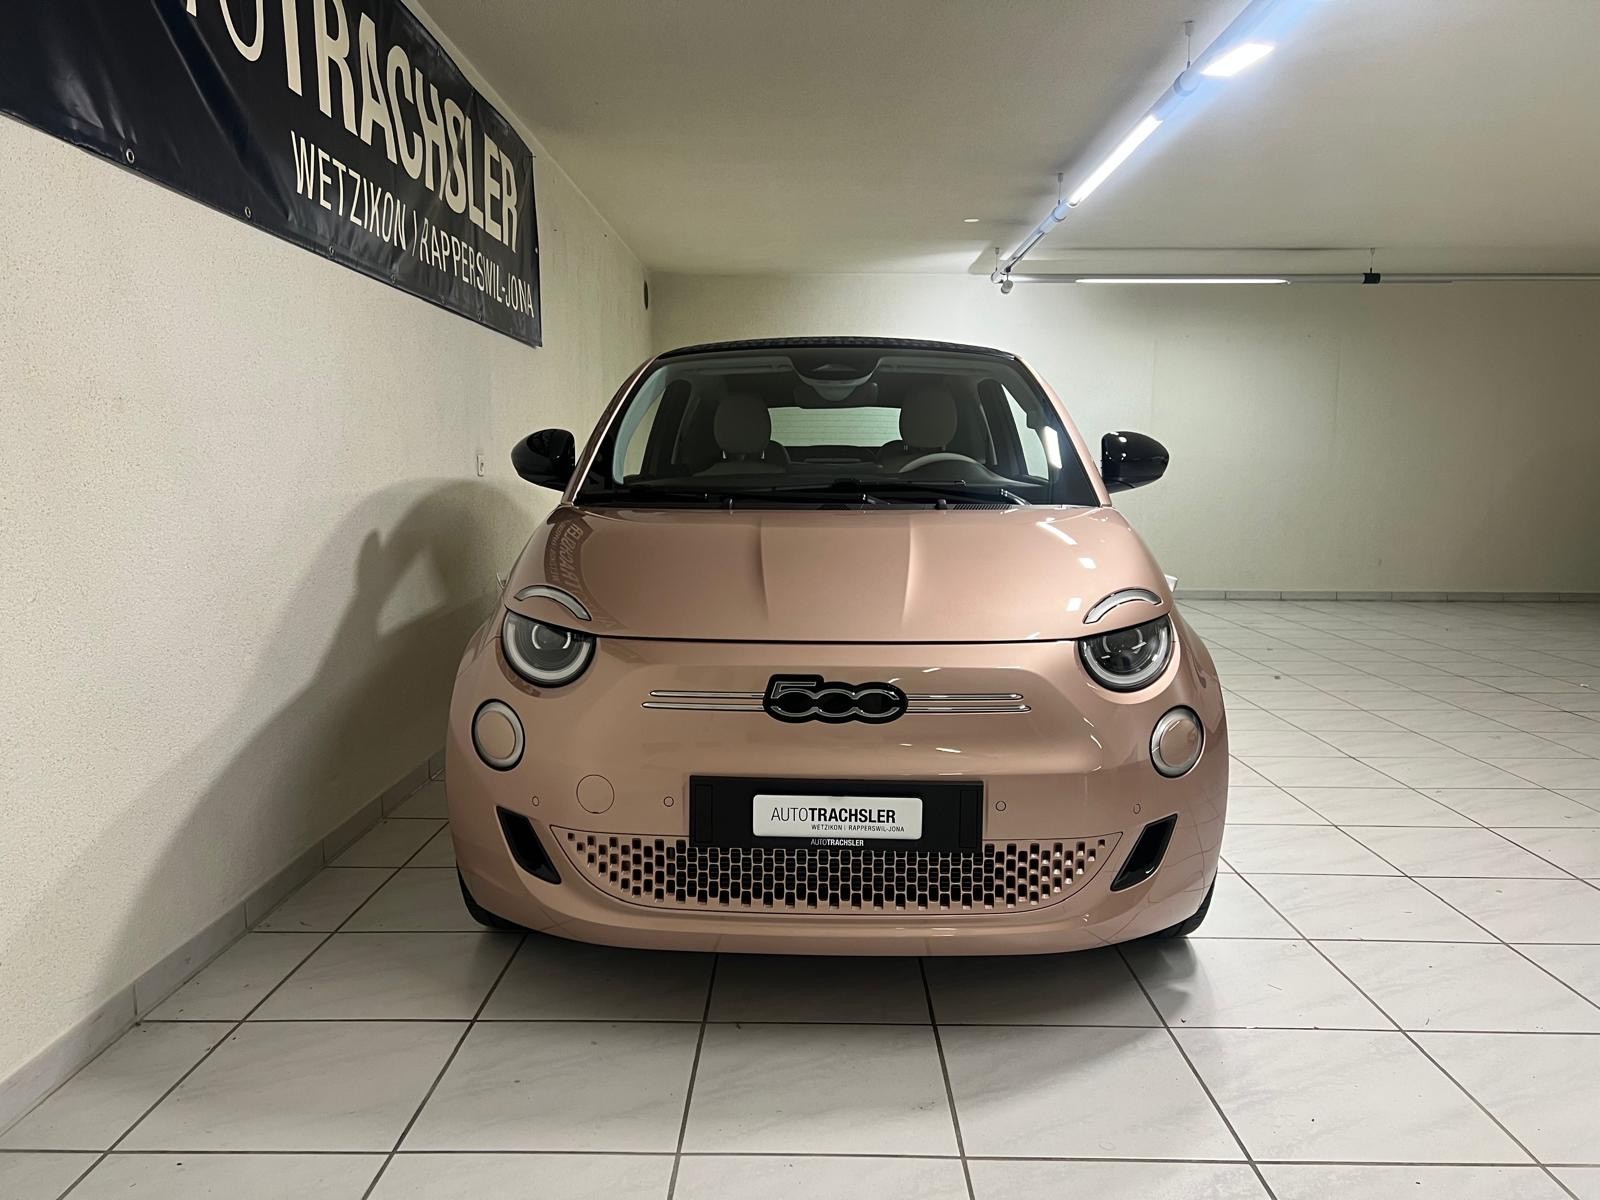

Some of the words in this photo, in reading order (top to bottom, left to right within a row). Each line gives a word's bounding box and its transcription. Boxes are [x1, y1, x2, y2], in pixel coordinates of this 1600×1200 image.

[186, 0, 519, 253] TRACHSLER
[290, 130, 407, 250] WETZIKON
[419, 217, 535, 318] RAPPERSWIL-JONA
[768, 679, 902, 720] 500
[770, 806, 896, 824] AUTOTRACHSLER
[848, 825, 905, 833] RAPPERSWIL-JONA
[810, 838, 864, 847] AUTOTRACHSLER
